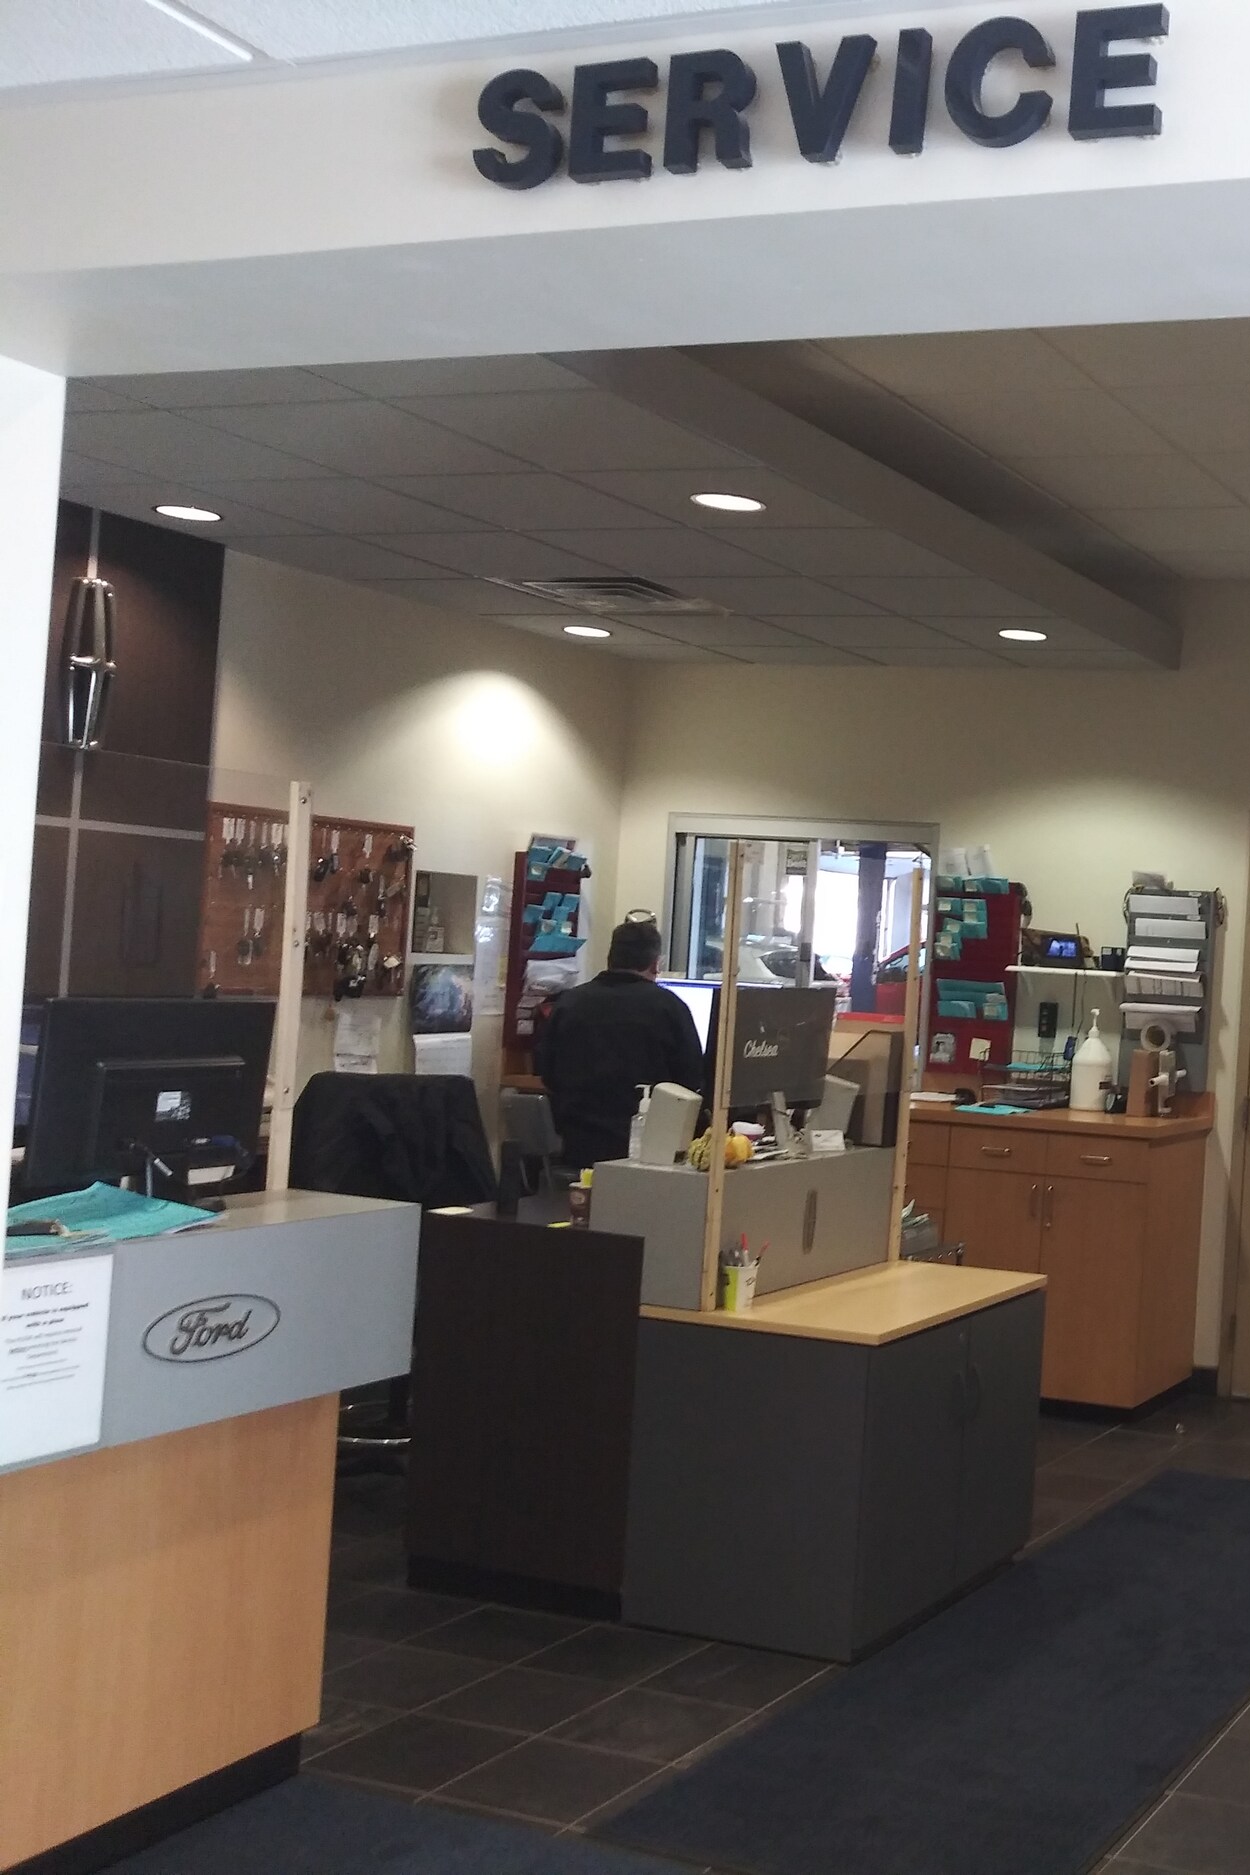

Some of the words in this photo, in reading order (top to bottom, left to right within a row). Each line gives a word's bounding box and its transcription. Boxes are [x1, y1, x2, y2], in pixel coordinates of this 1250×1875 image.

[472, 3, 1170, 190] SERVICE
[743, 1040, 780, 1058] Chelsea
[169, 1301, 253, 1356] Ford
